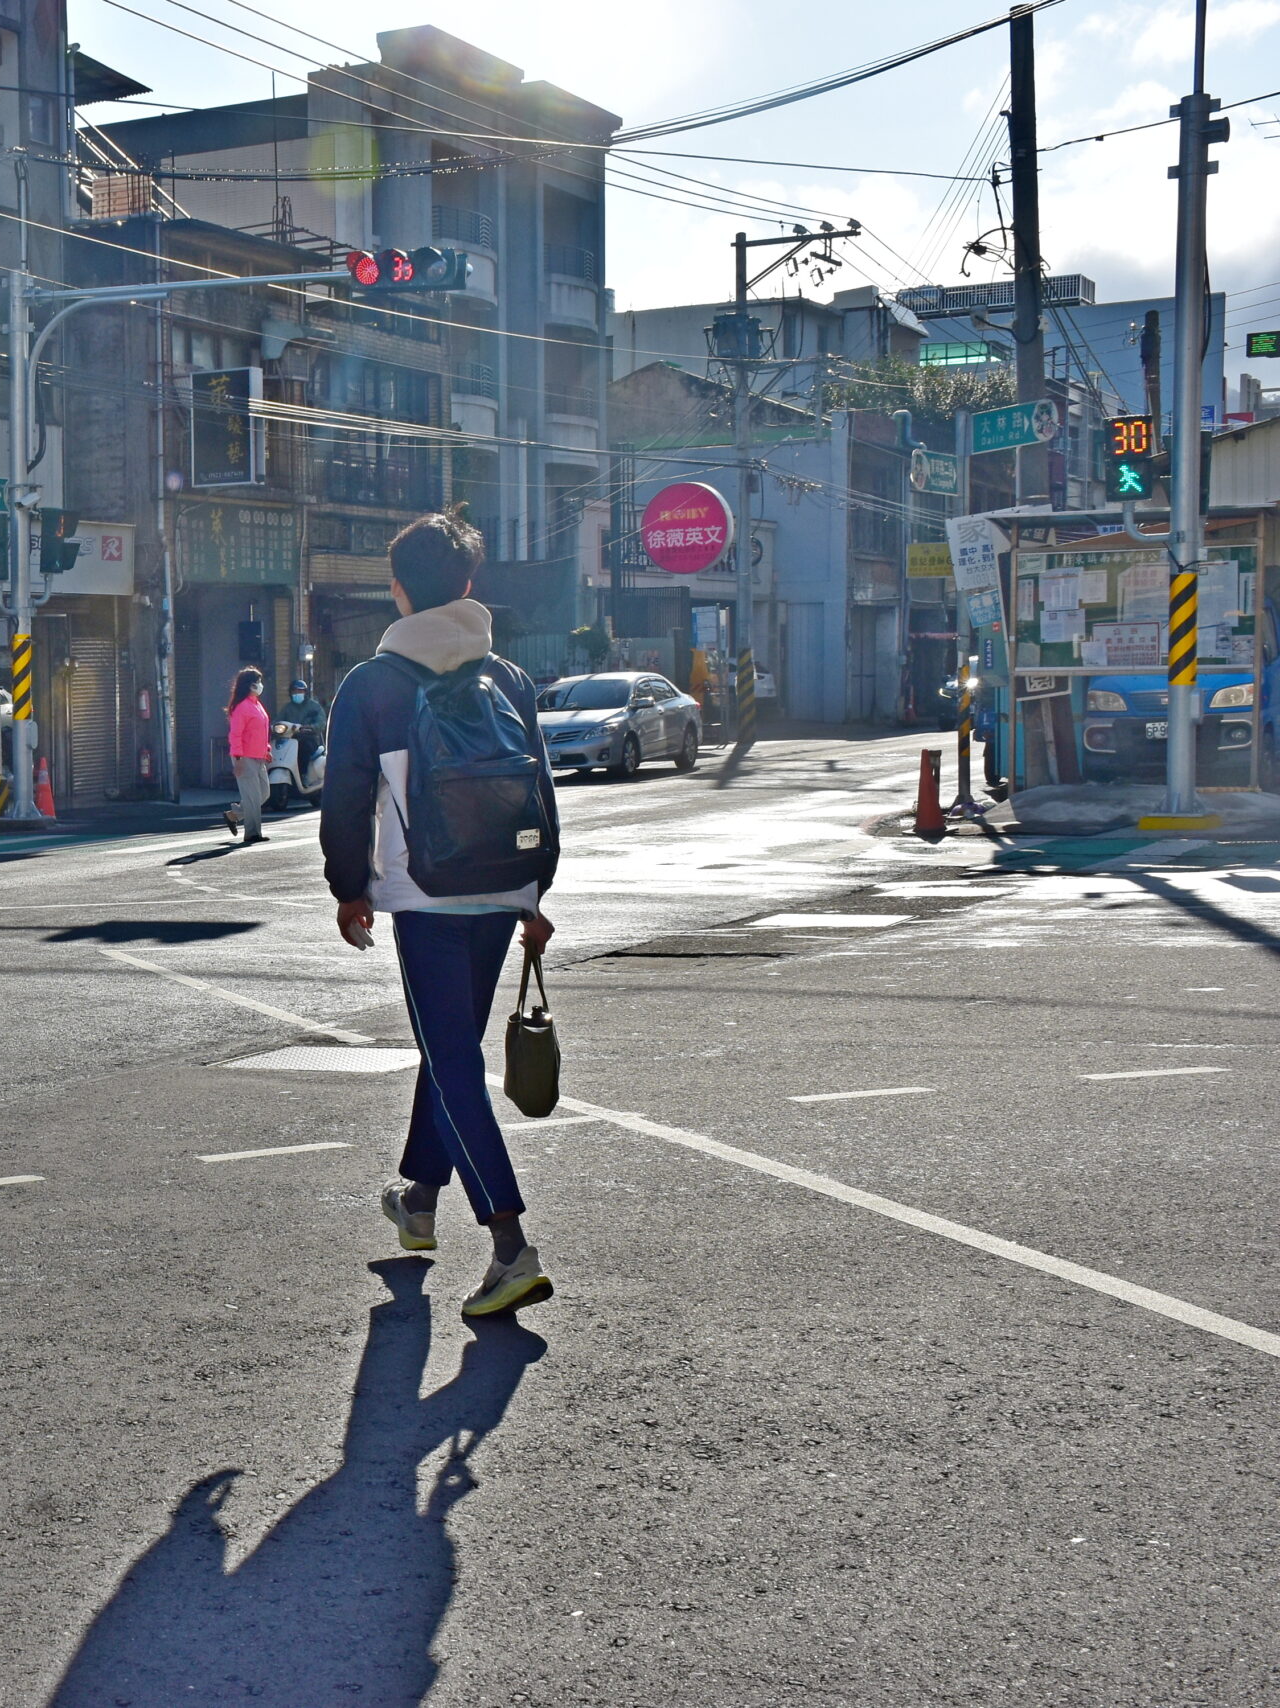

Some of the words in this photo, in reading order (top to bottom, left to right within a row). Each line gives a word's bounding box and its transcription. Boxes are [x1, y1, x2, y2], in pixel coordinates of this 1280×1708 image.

[1114, 420, 1147, 455] 30
[647, 525, 723, 549] 徐薇英文
